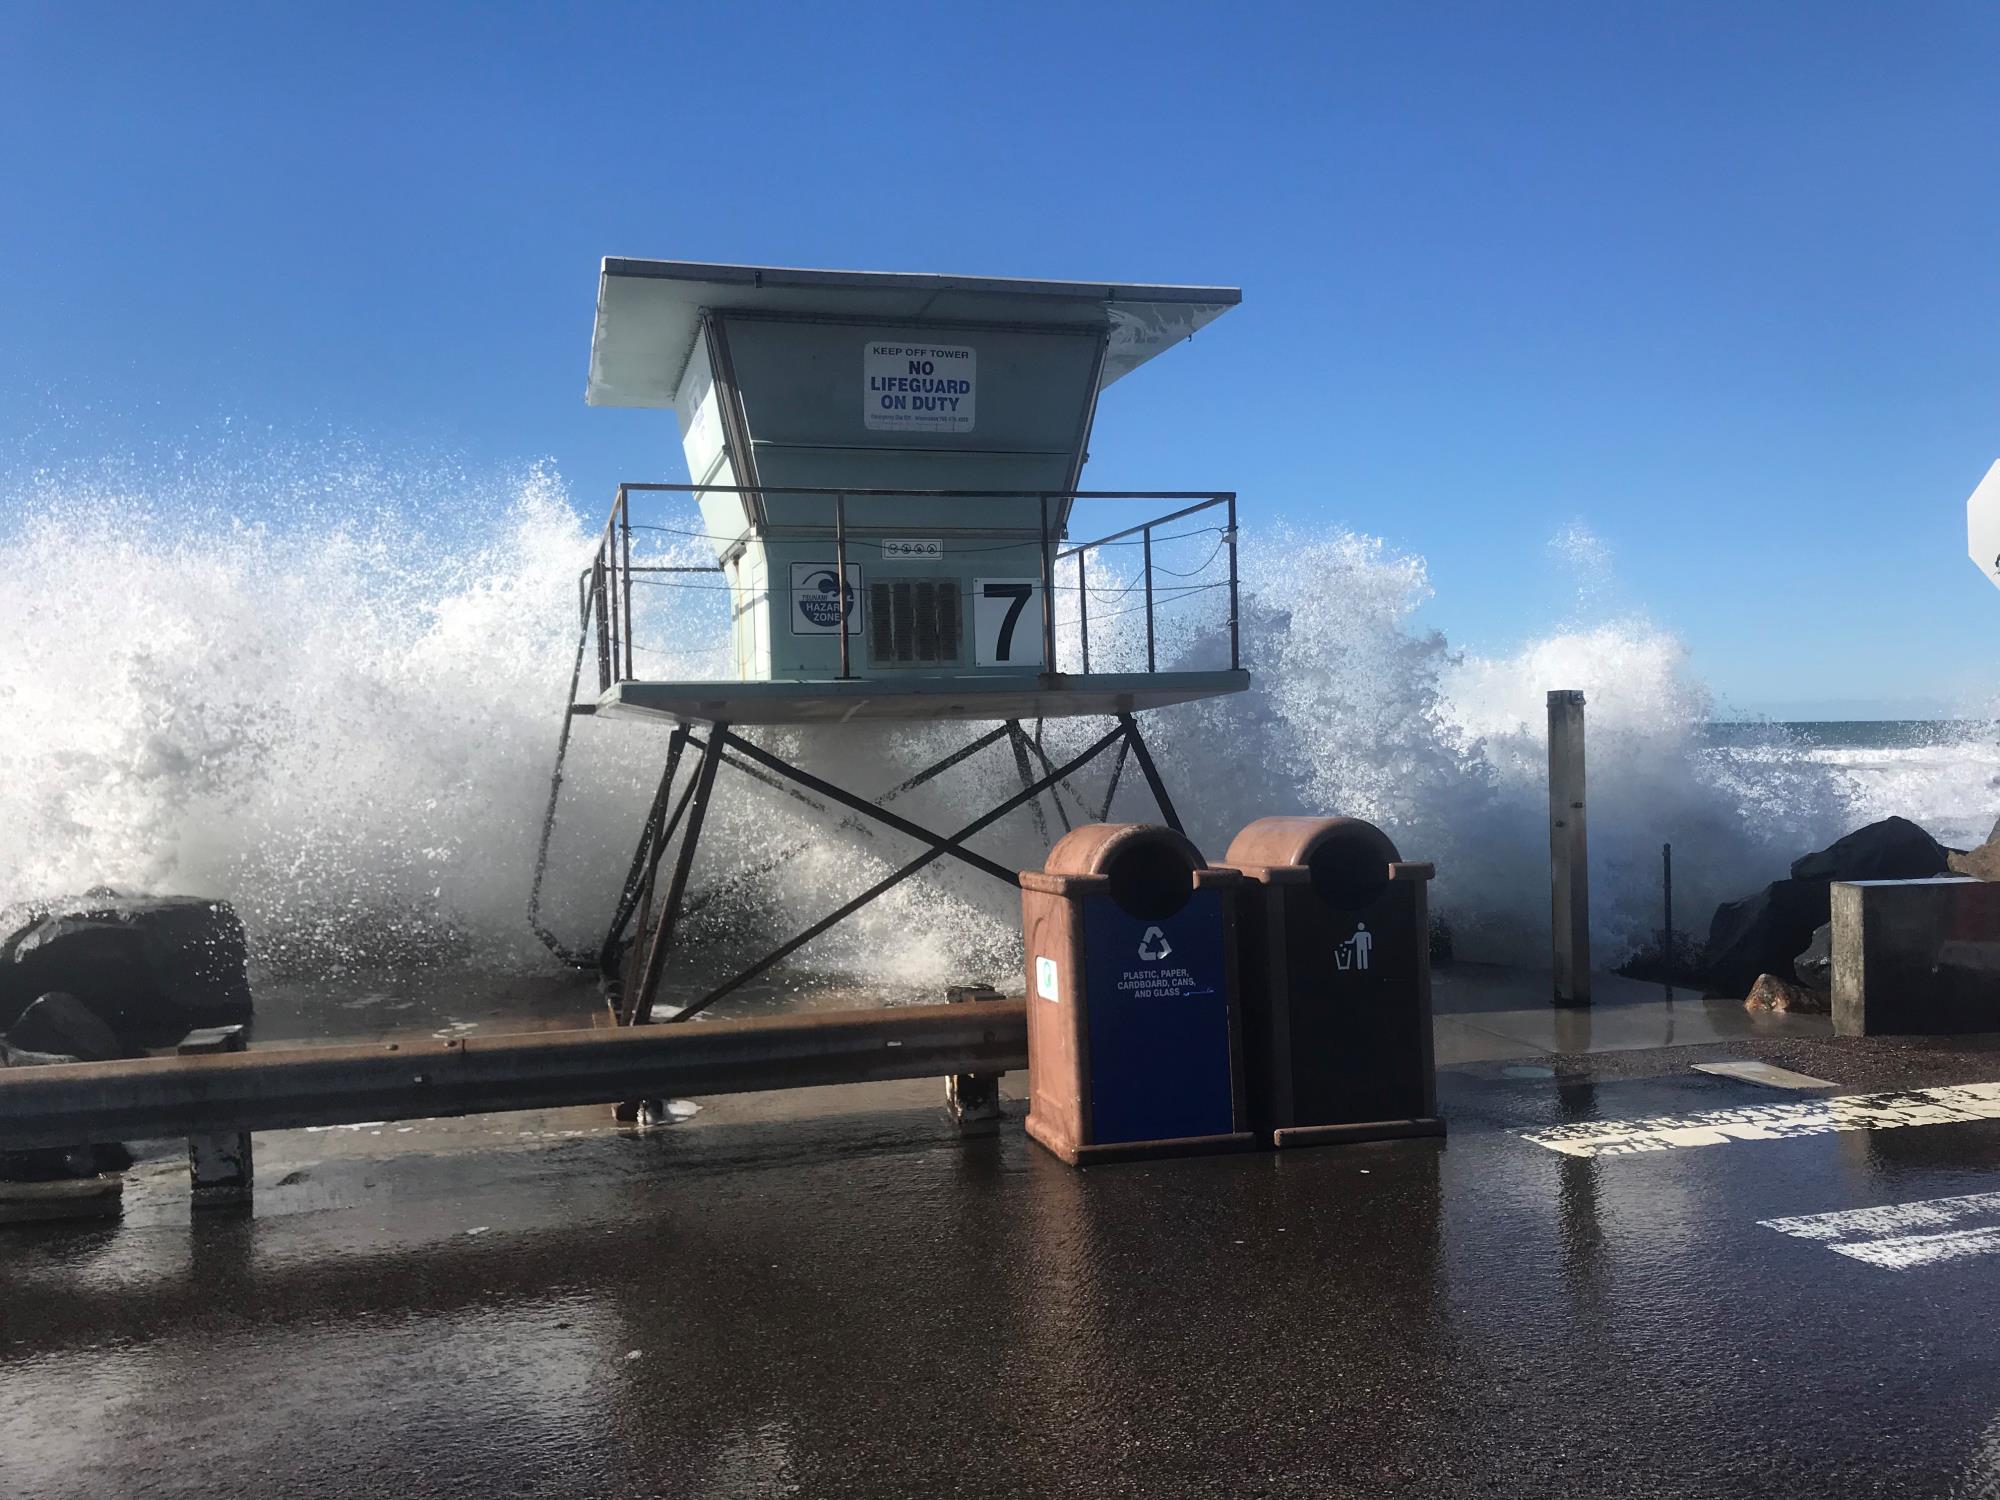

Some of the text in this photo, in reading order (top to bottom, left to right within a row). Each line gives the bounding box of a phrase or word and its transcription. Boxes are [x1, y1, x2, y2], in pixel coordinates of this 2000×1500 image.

[873, 347, 969, 358] KEEP OFF TOWER
[908, 361, 934, 375] NO
[871, 376, 970, 394] LIFEGUARD
[881, 395, 960, 411] ON DUTY
[806, 603, 840, 611] HAZAR
[813, 613, 840, 621] ZONE
[983, 583, 1033, 661] 7
[1123, 968, 1189, 980] PLASTIC, PAPER,
[1117, 977, 1197, 990] CARDBOARD, CANS,
[1134, 988, 1180, 999] AND GLASS
